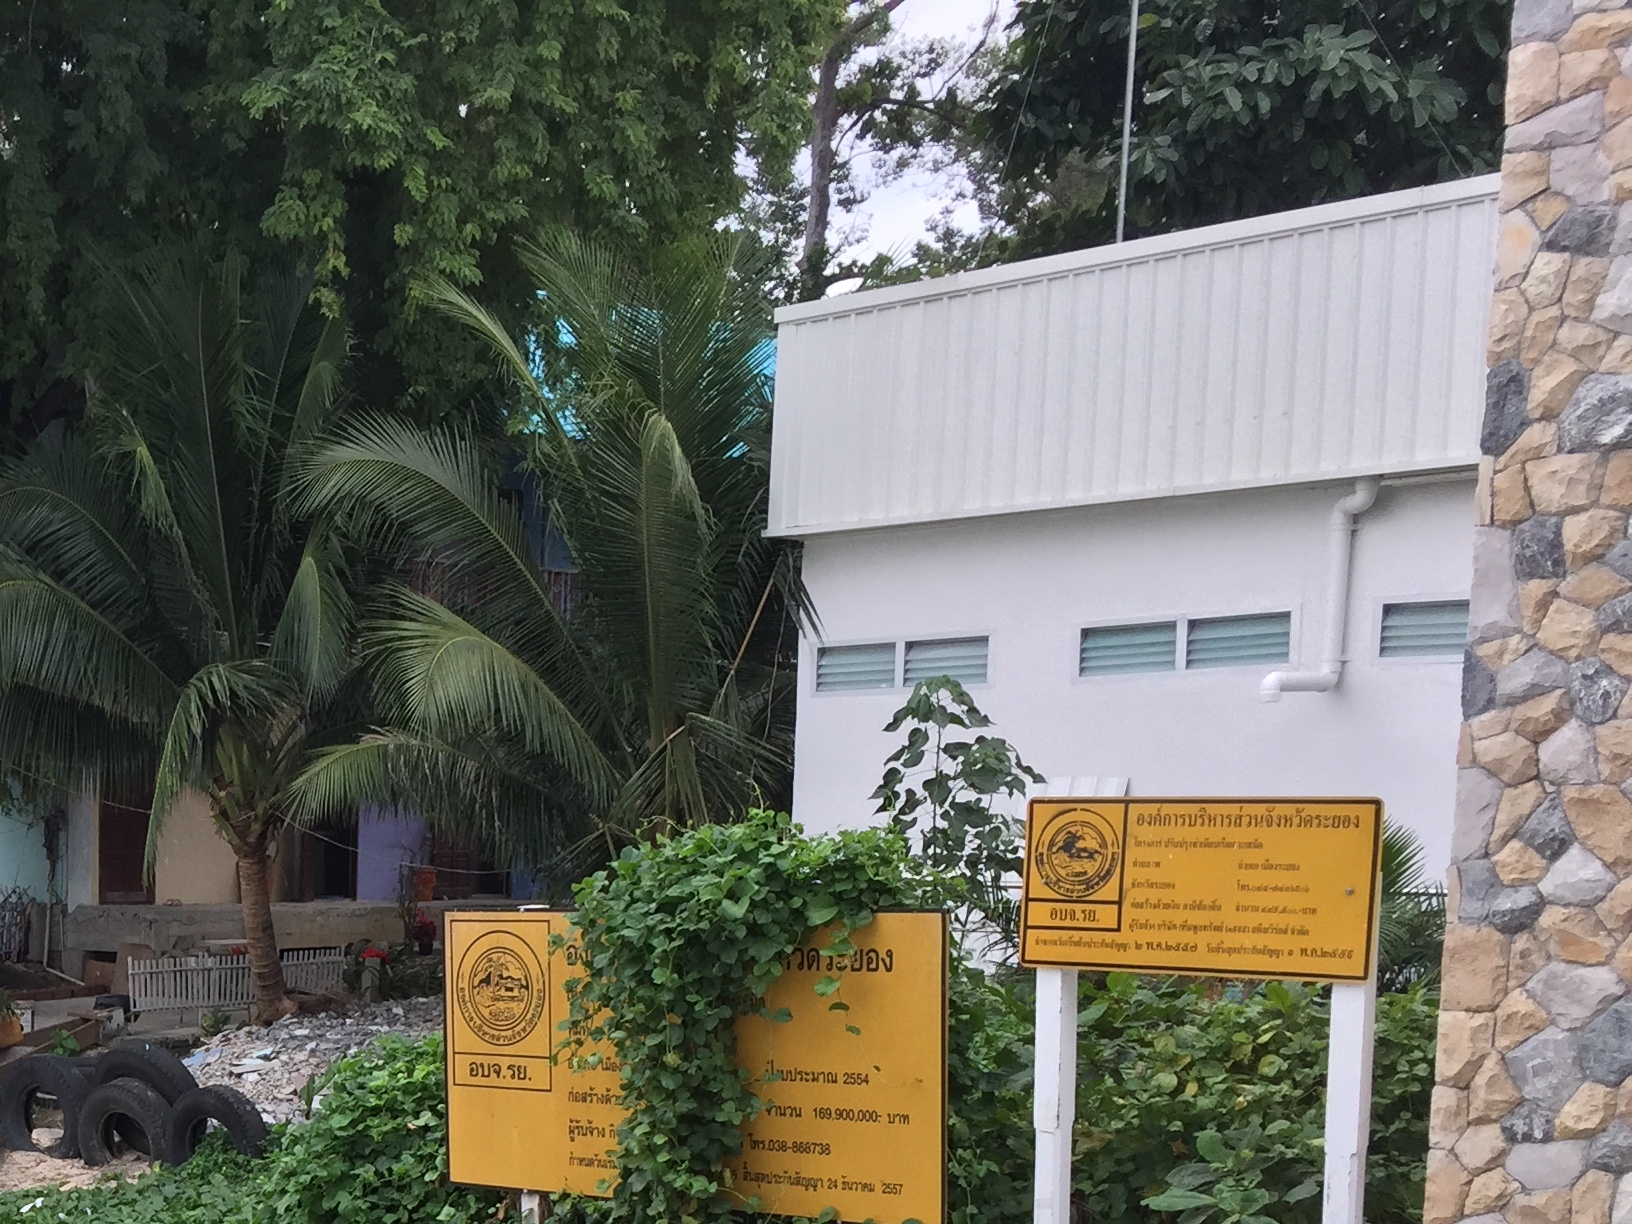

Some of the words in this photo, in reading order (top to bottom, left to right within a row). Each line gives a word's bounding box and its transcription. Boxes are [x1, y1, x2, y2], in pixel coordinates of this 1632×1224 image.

[1136, 806, 1360, 829] องค์การบริหารส่วนจังหวัดระยอง
[1050, 908, 1100, 922] อบจ.รย.
[469, 1061, 532, 1082] อบจ.รย.
[843, 1072, 870, 1086] 2554
[887, 1112, 910, 1125] บาท
[568, 1117, 606, 1142] ผู้รับจ้าง
[827, 1178, 838, 1190] 24
[841, 1175, 875, 1192] ธันวาคม
[882, 1182, 904, 1196] 2557
